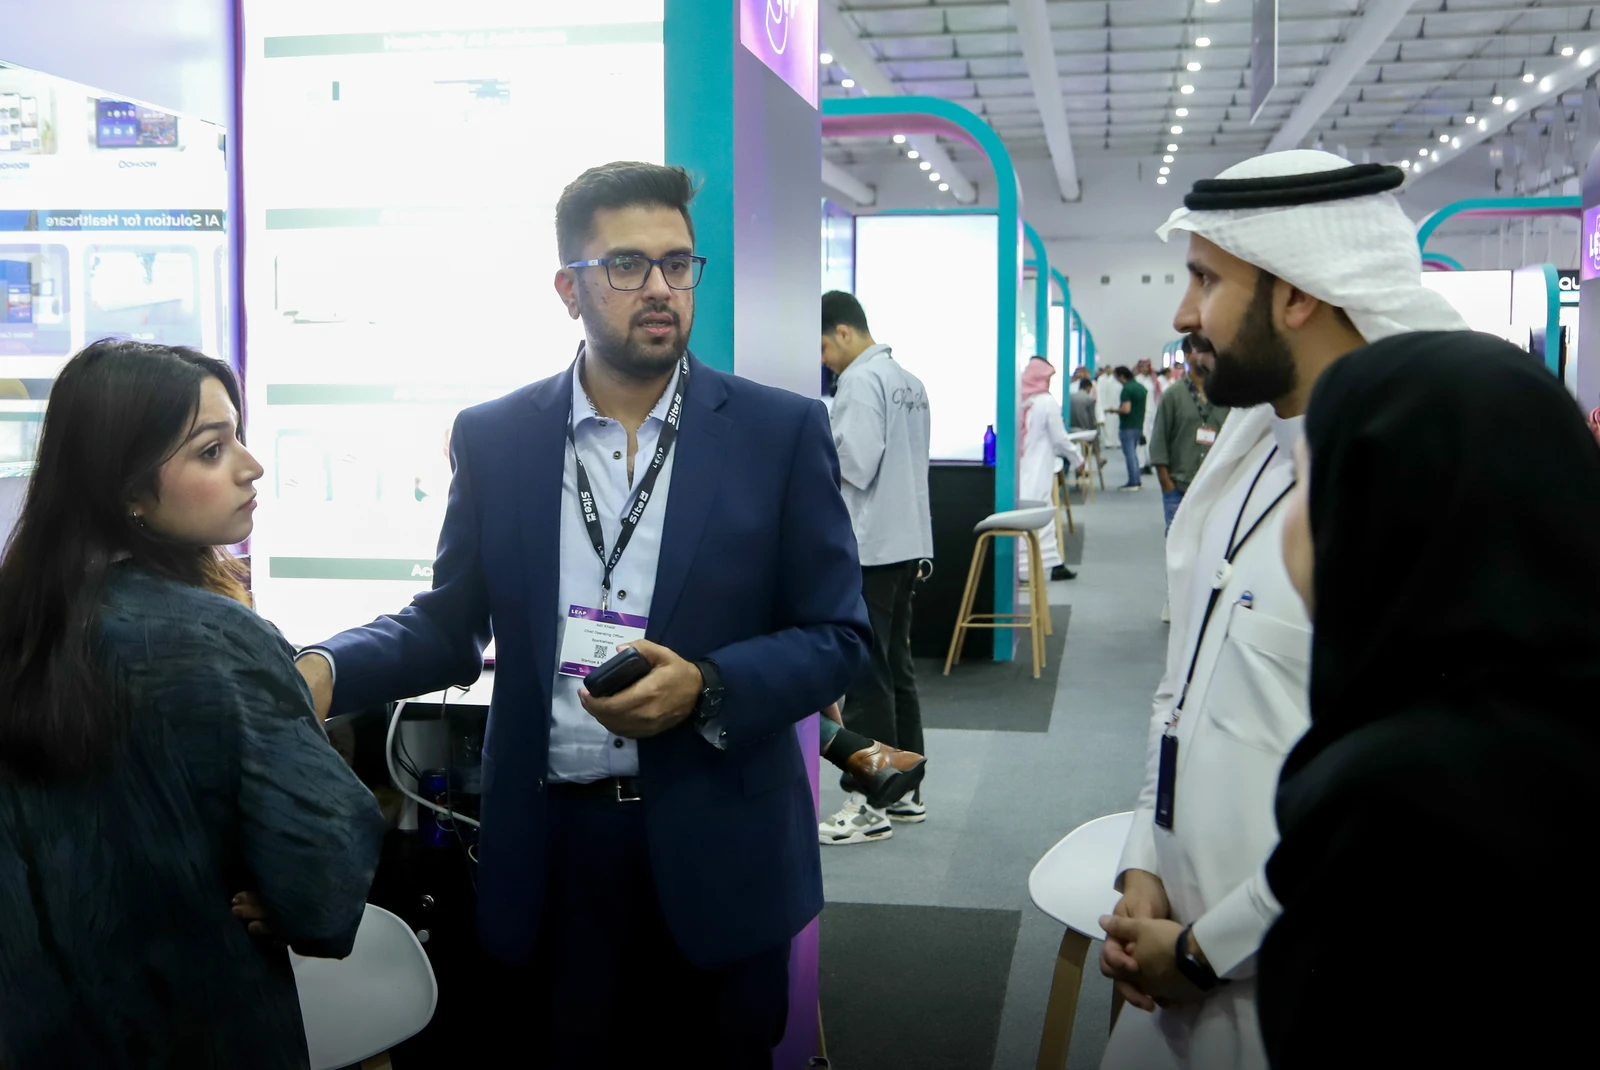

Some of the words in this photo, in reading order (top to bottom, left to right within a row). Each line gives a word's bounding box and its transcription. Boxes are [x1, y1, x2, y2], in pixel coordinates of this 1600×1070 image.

[667, 403, 680, 426] Site
[652, 447, 664, 469] LEAP
[580, 491, 593, 513] Site
[629, 502, 645, 524] Site
[608, 547, 621, 569] LEAP
